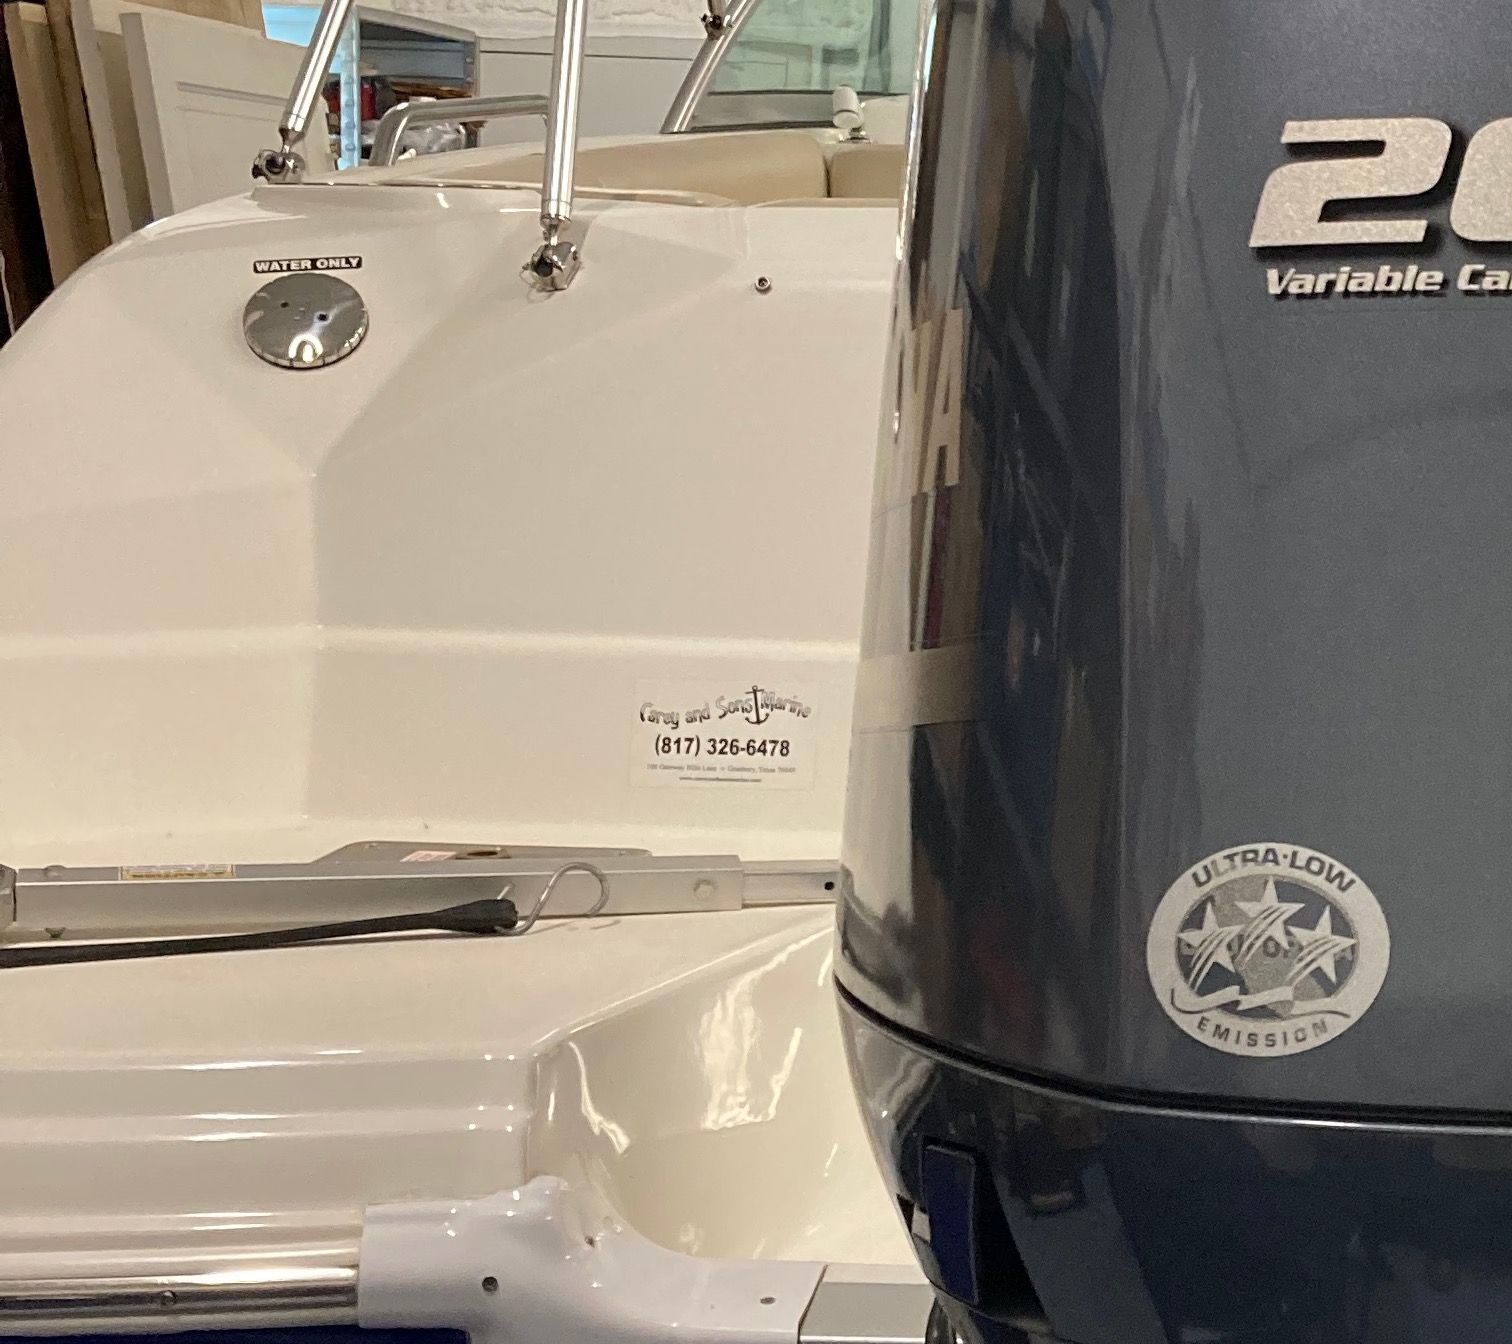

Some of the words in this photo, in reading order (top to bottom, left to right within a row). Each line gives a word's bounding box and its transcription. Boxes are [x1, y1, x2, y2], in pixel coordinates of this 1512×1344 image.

[255, 260, 311, 272] WATER
[316, 257, 360, 268] ONLY
[1265, 265, 1444, 297] Variable
[655, 734, 701, 756] (817)
[706, 738, 791, 757] 326-6478
[1196, 1016, 1329, 1048] EMISSION
